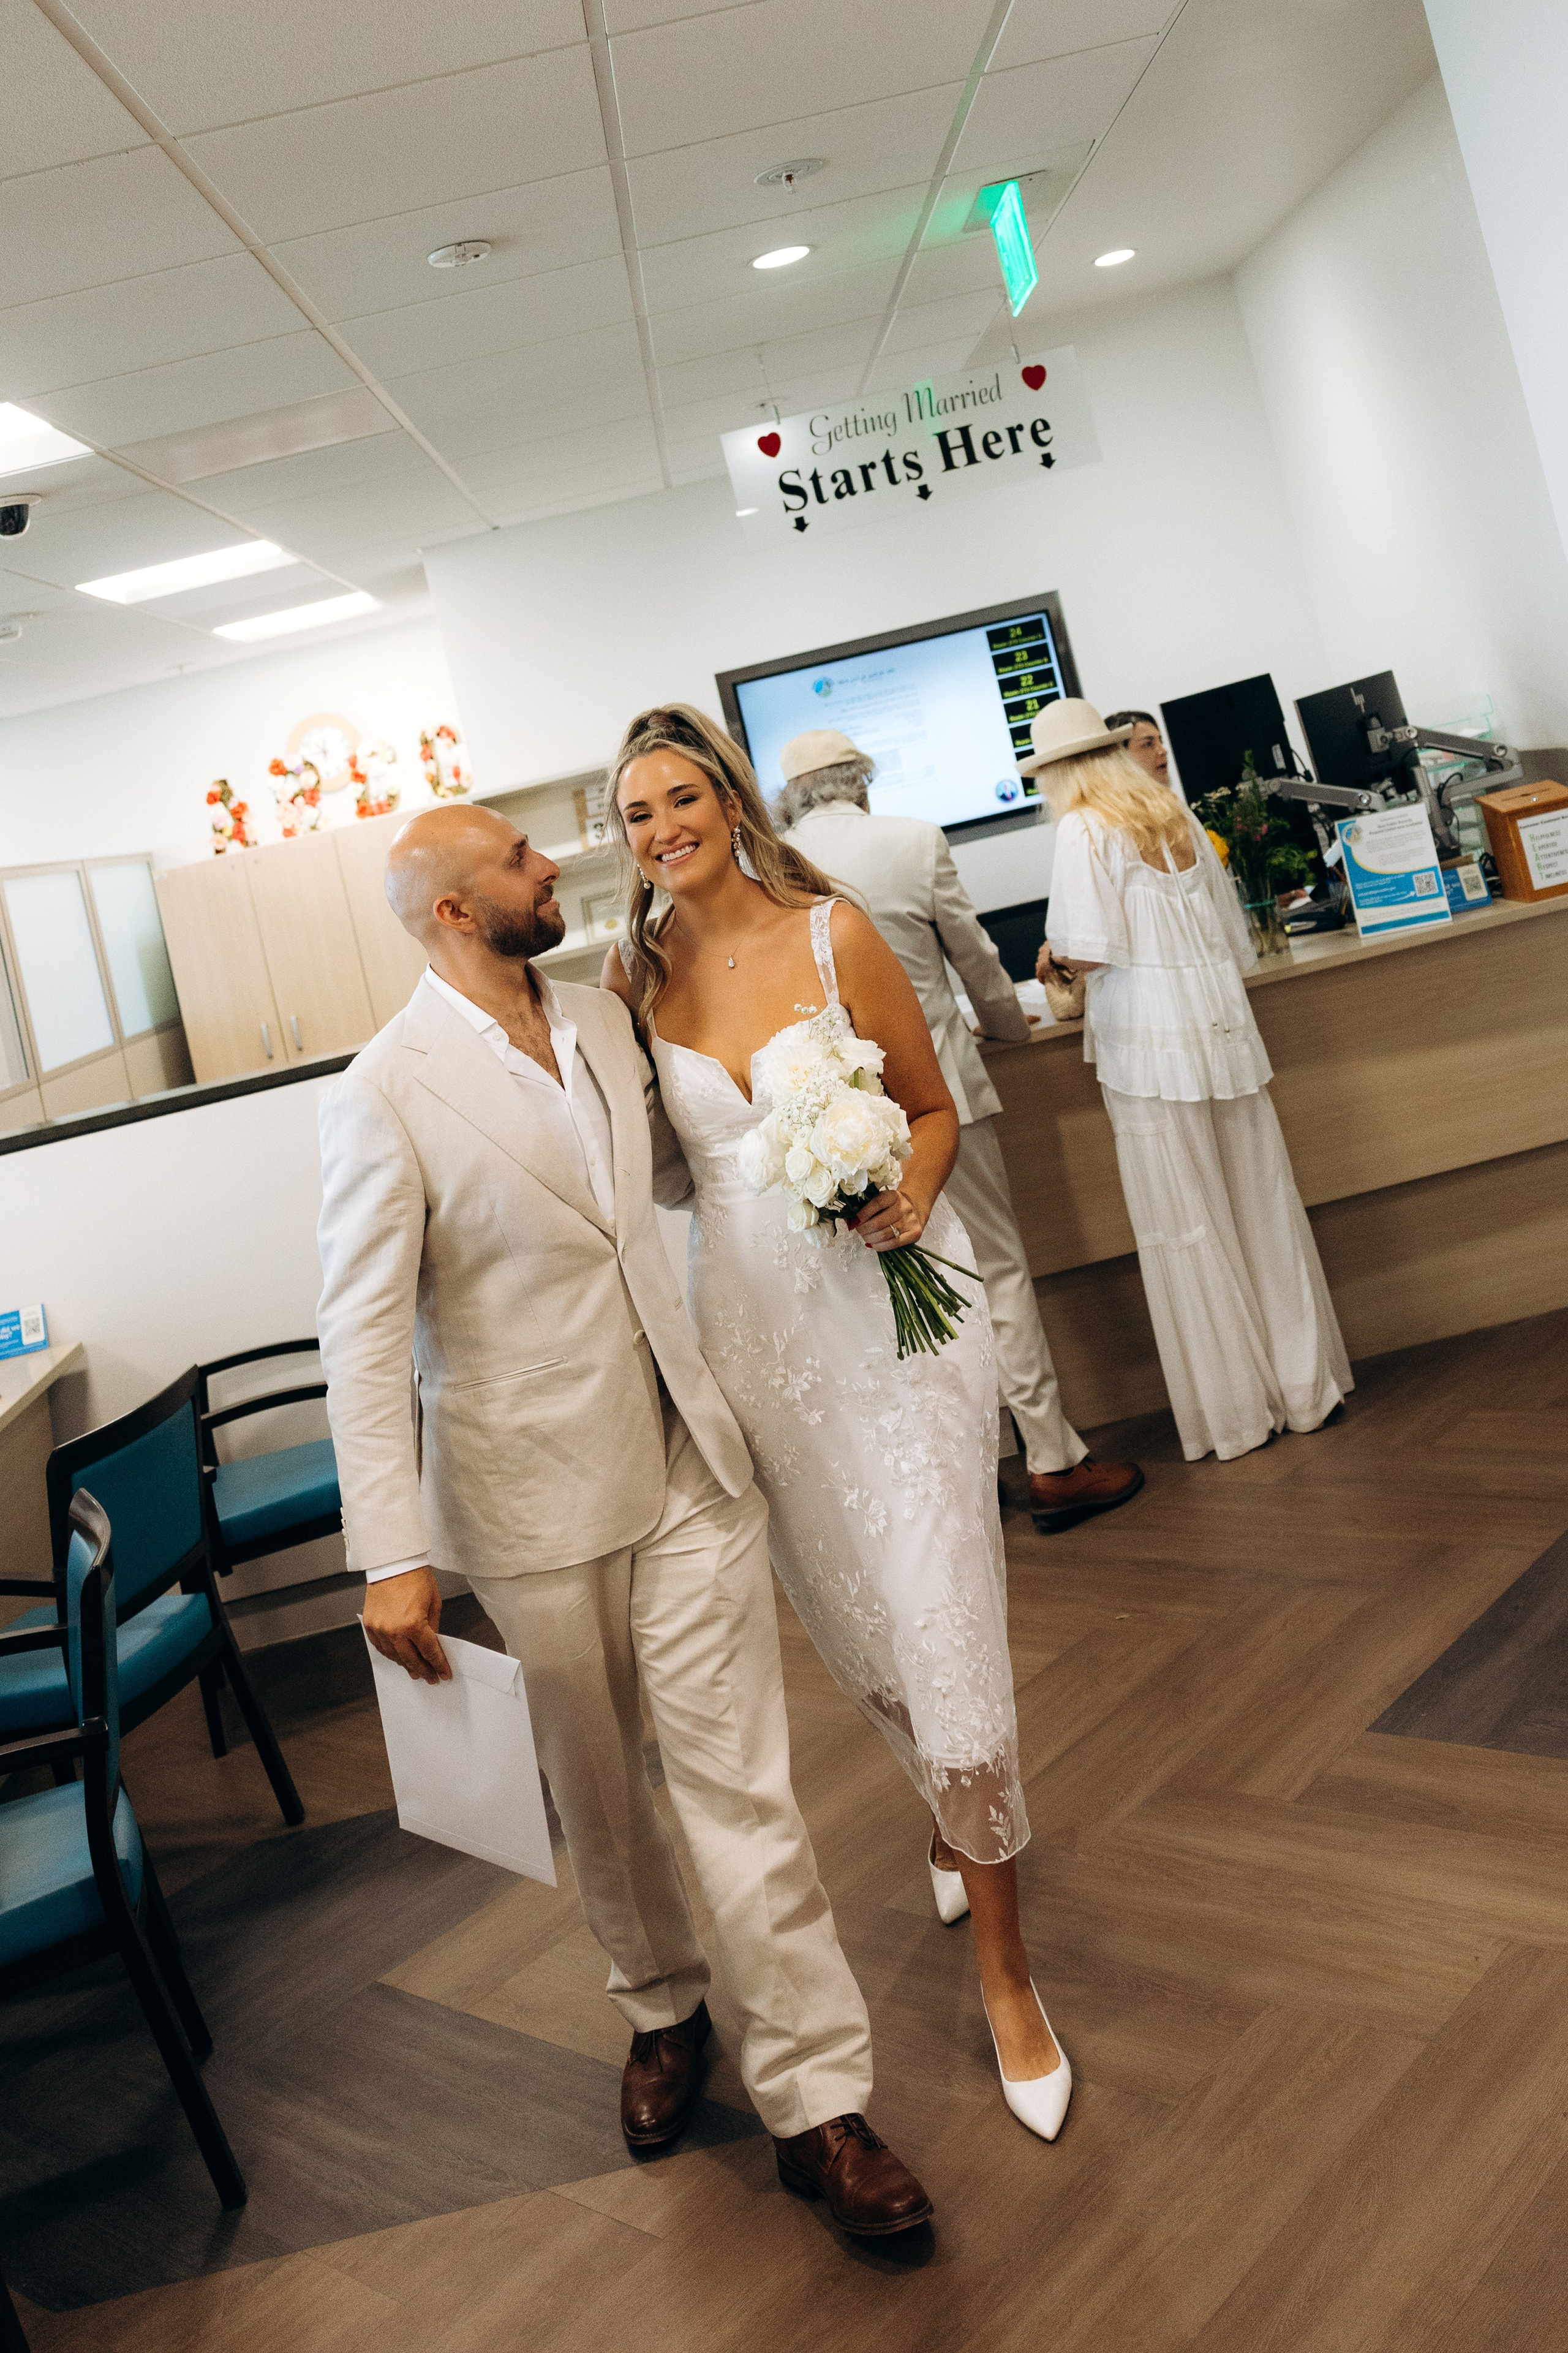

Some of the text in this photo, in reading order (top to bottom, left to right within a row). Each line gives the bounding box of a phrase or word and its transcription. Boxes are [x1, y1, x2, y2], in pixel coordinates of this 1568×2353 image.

[809, 372, 1003, 456] Getting Married
[778, 416, 1054, 513] Starts Here
[1009, 626, 1022, 638] 24
[1014, 650, 1028, 662] 23
[1019, 674, 1034, 687] 22
[1025, 698, 1040, 711] 21
